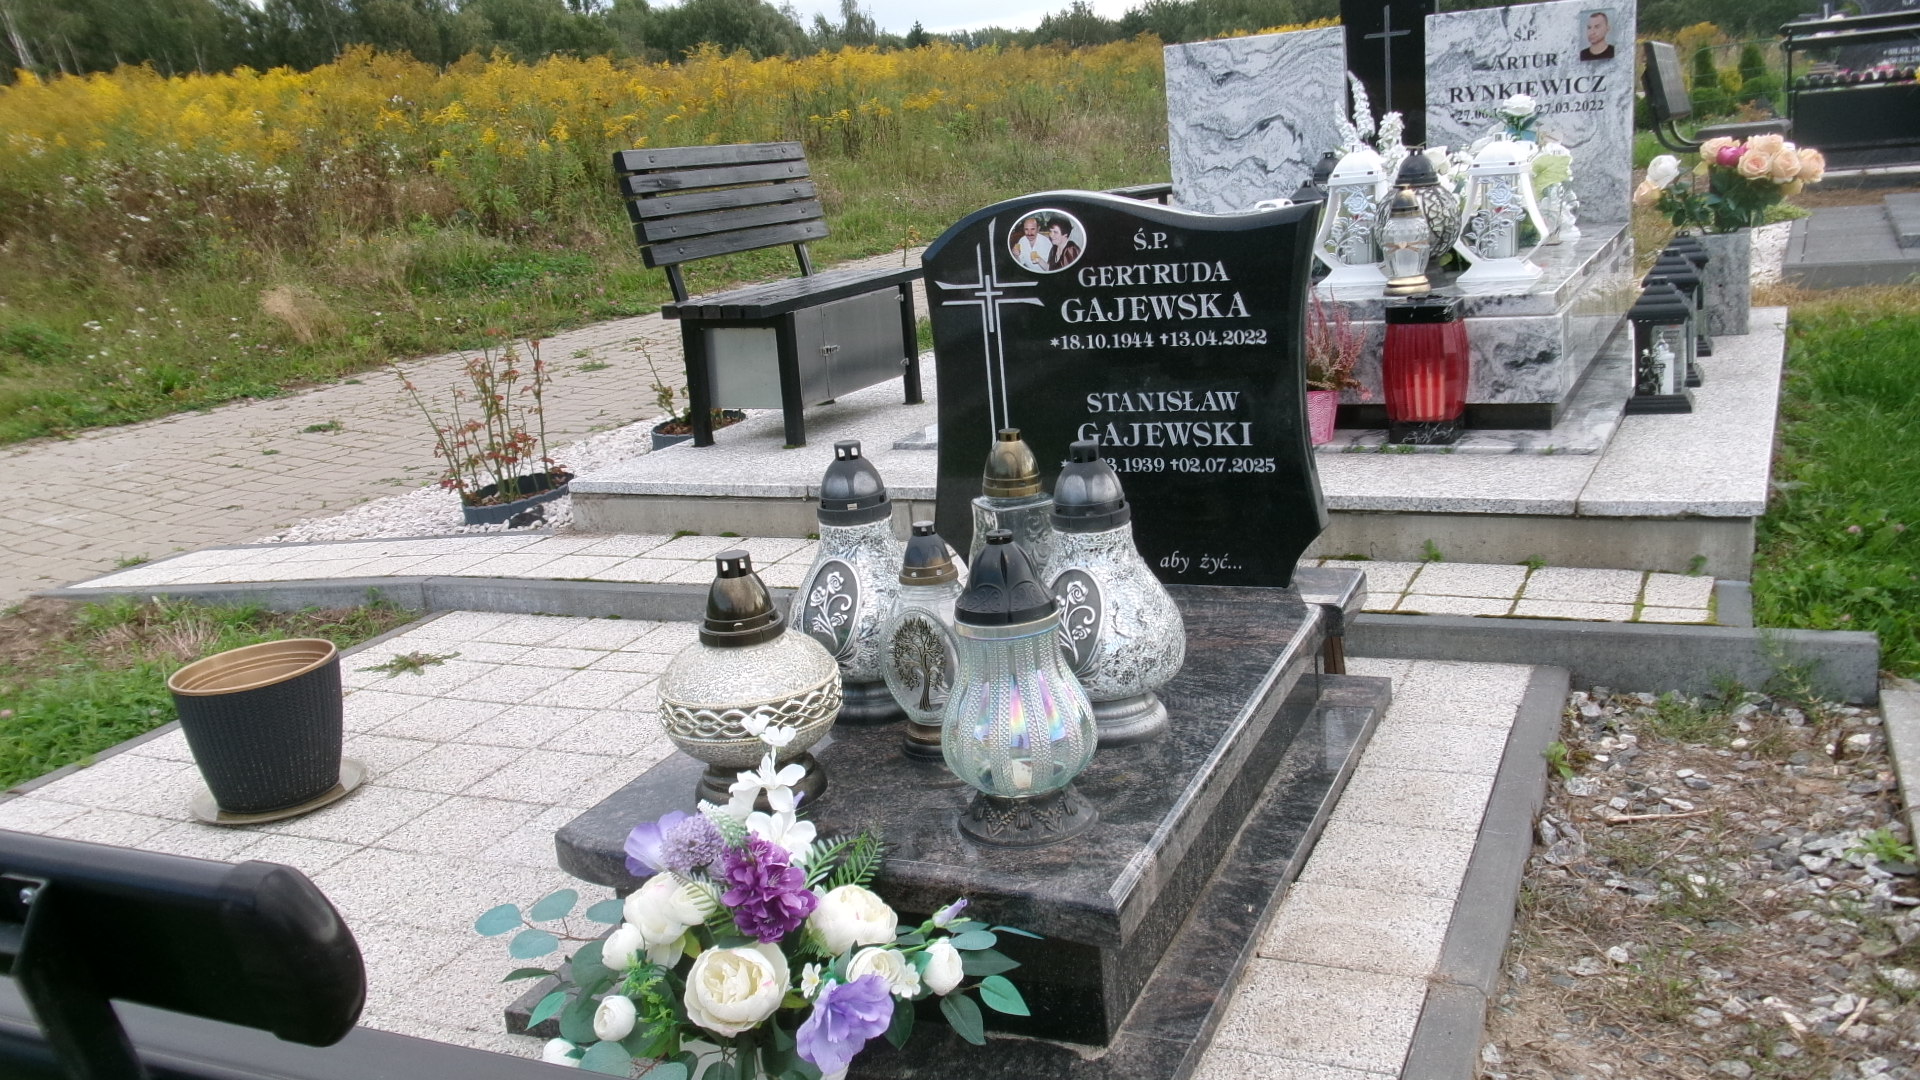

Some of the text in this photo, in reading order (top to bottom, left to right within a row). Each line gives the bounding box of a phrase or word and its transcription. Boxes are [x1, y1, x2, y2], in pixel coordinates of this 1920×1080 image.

[1493, 53, 1559, 71] ARTUR
[1450, 75, 1607, 103] RYNKIEWICZ
[1133, 228, 1169, 250] Ś.P.
[1077, 260, 1231, 288] GERTRUDA
[1060, 291, 1252, 324] GAJEWSKA
[1087, 390, 1240, 413] STANISŁAW
[1077, 421, 1253, 448] GAJEWSKI
[1159, 551, 1243, 575] aby żyć...
